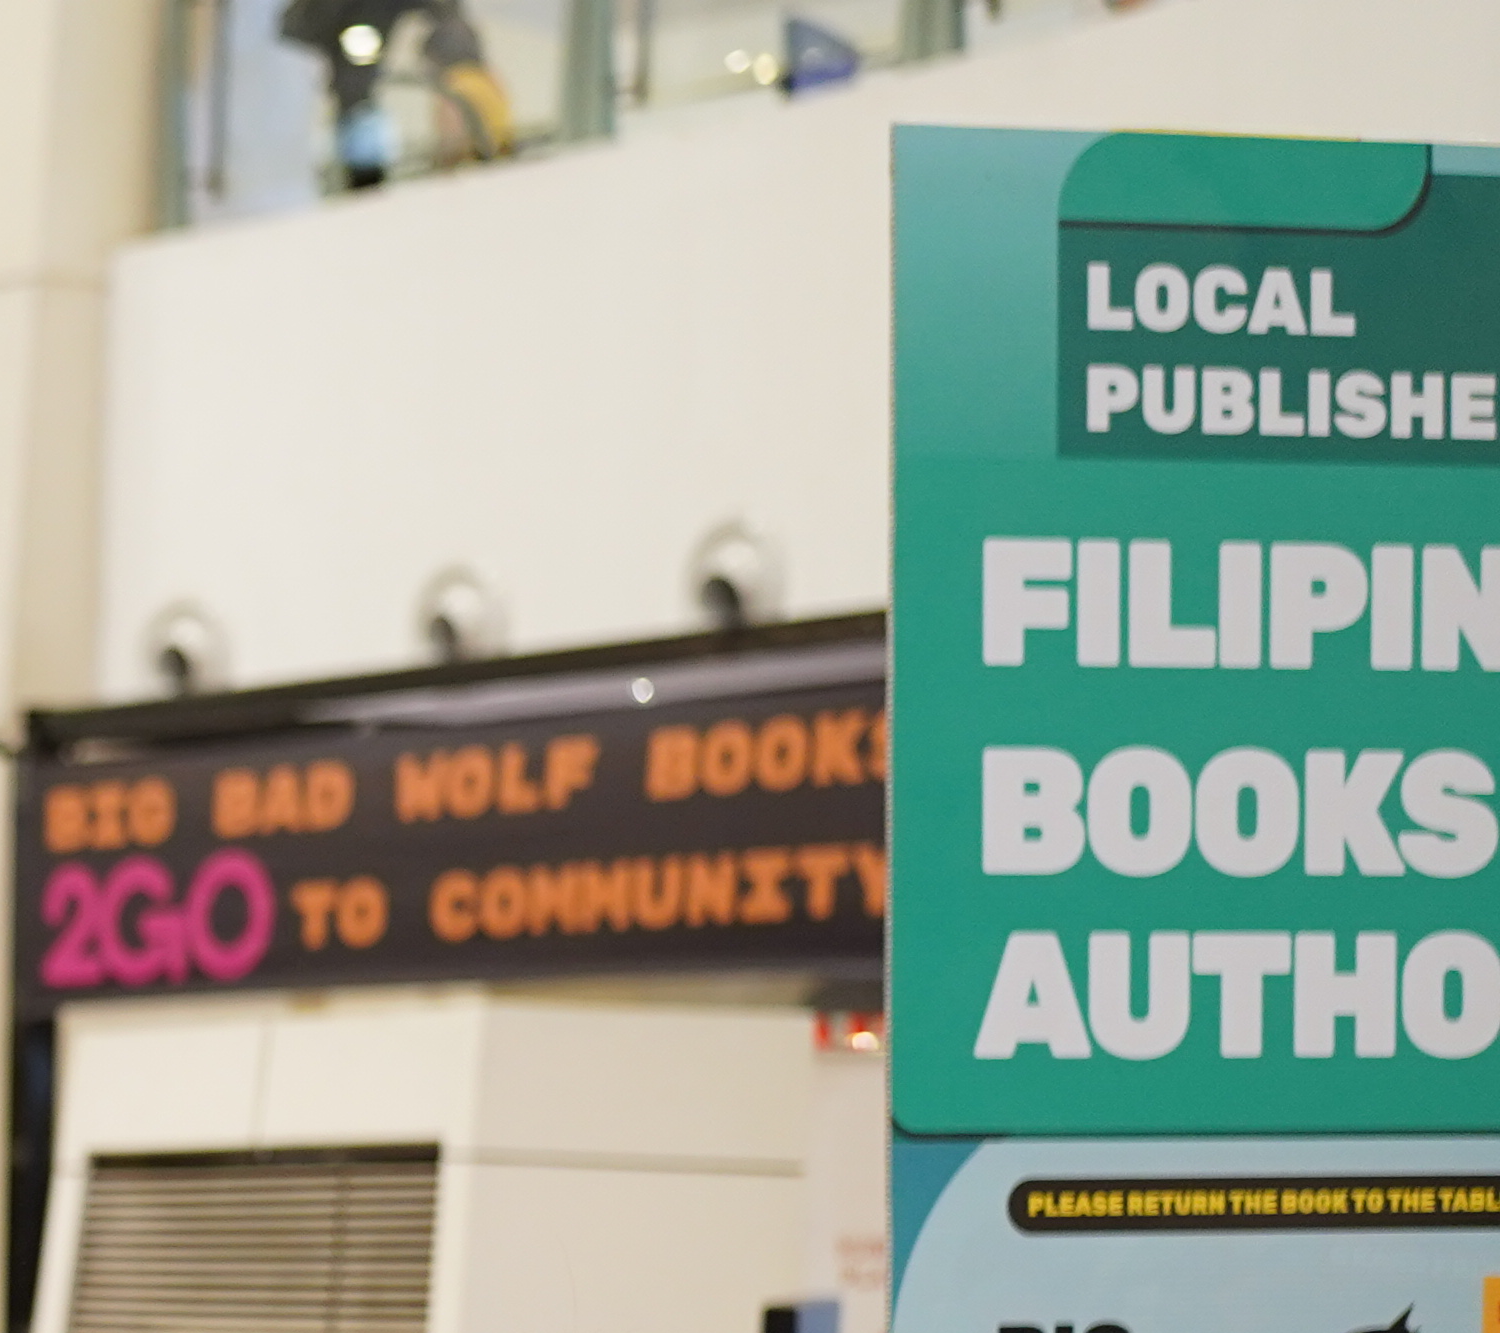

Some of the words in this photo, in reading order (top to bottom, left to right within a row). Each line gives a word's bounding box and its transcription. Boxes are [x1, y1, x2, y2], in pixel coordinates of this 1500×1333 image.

[1085, 263, 1356, 337] LOCAL
[43, 775, 175, 853] BIG
[212, 761, 356, 838] BAD
[395, 734, 598, 822] WOLF
[981, 746, 1499, 880] BOOKS
[38, 850, 277, 987] 2GO
[291, 877, 388, 951] TO
[1027, 1191, 1124, 1217] PLEASE
[1128, 1190, 1225, 1216] RETURN
[1229, 1190, 1278, 1215] THE
[1281, 1189, 1349, 1215] BOOK
[1350, 1188, 1384, 1214] TO
[1387, 1187, 1436, 1213] THE
